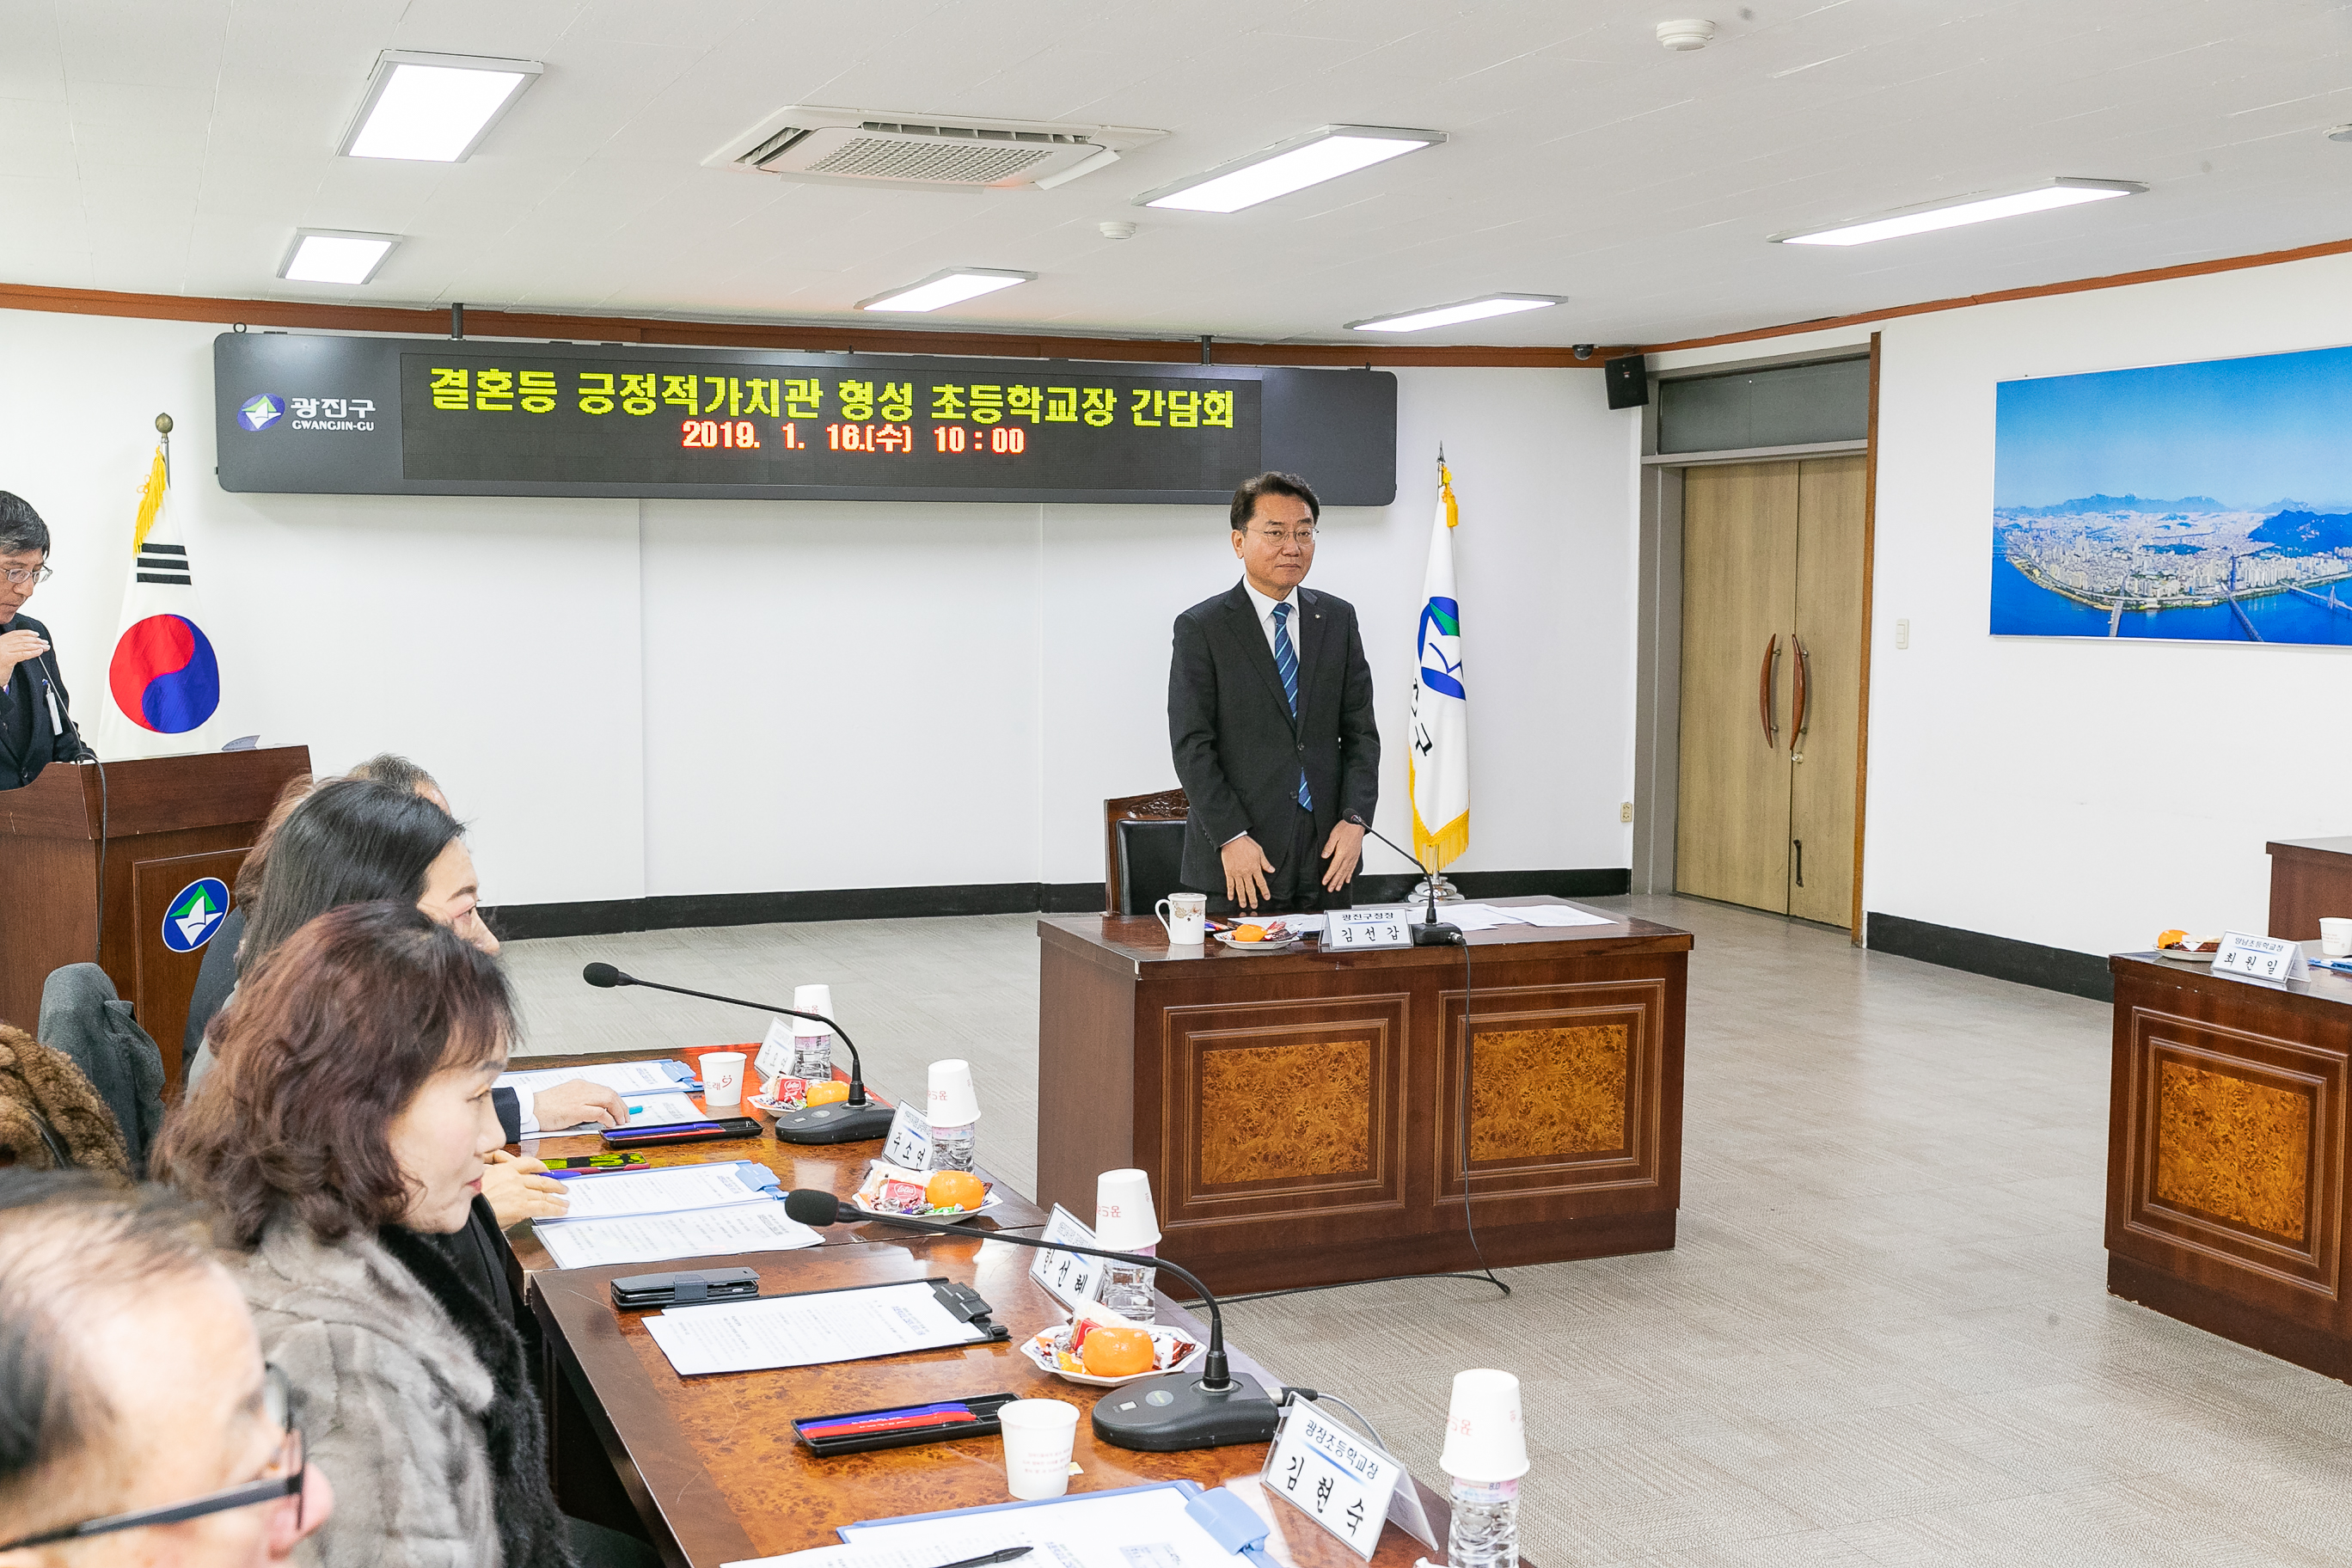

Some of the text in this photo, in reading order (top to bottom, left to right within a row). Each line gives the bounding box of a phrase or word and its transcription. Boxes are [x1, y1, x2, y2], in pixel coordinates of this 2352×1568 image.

[290, 397, 377, 418] 광진구
[430, 368, 1234, 429] 결혼등 긍정적가치관 형성 초등학교장 간담회
[291, 420, 375, 432] GWANGJIN-GU
[682, 420, 761, 449] 2019.
[782, 423, 805, 449] 1.
[1305, 1419, 1378, 1479] 광장초등학교장
